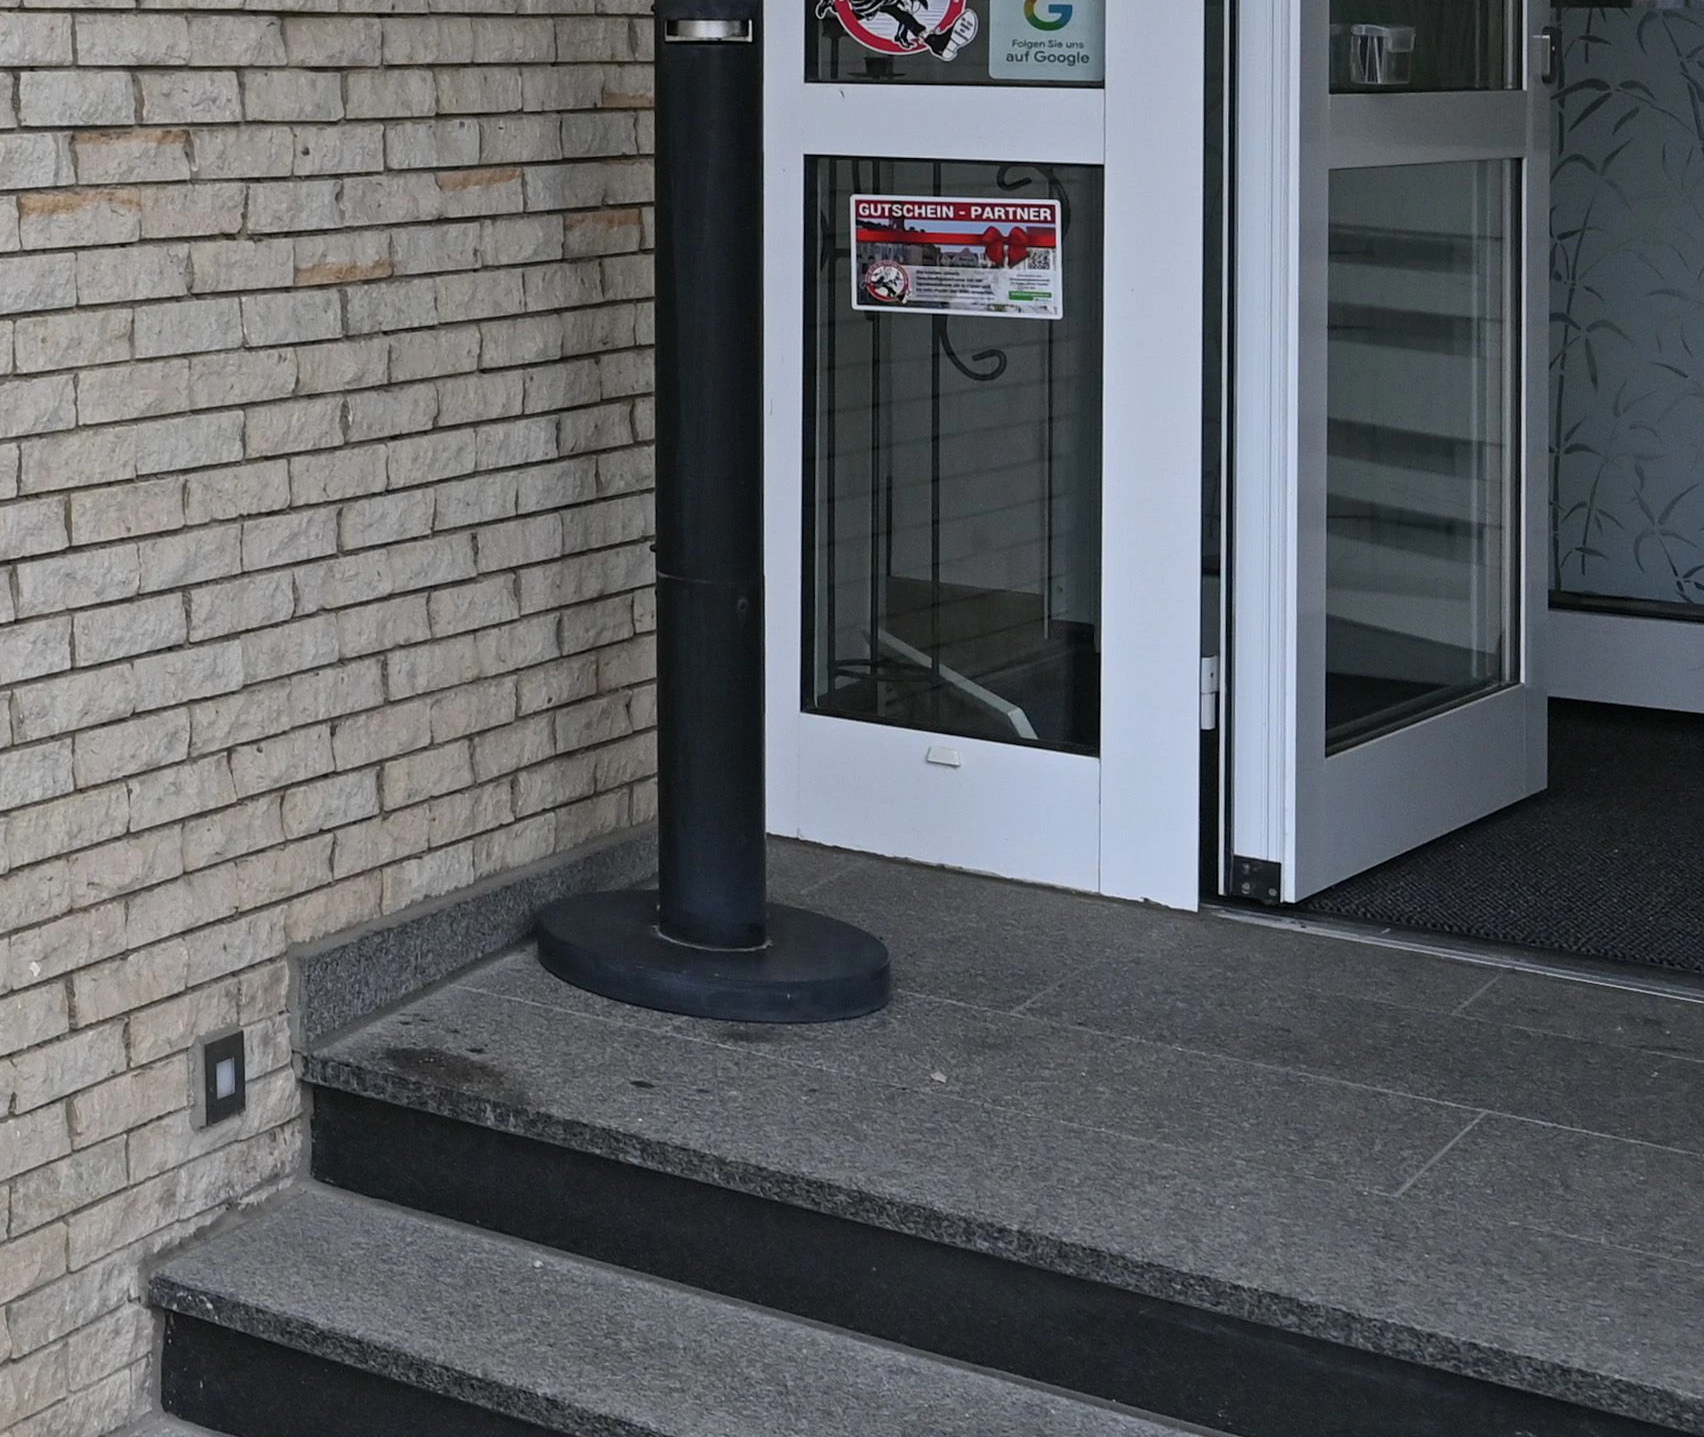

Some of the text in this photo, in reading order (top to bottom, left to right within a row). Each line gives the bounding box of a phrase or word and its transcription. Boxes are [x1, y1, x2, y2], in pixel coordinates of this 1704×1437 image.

[1011, 39, 1085, 50] Folgen Sie uns
[1006, 50, 1090, 67] auf Google
[858, 203, 955, 219] GUTSCHEIN
[970, 206, 1052, 221] PARTNER
